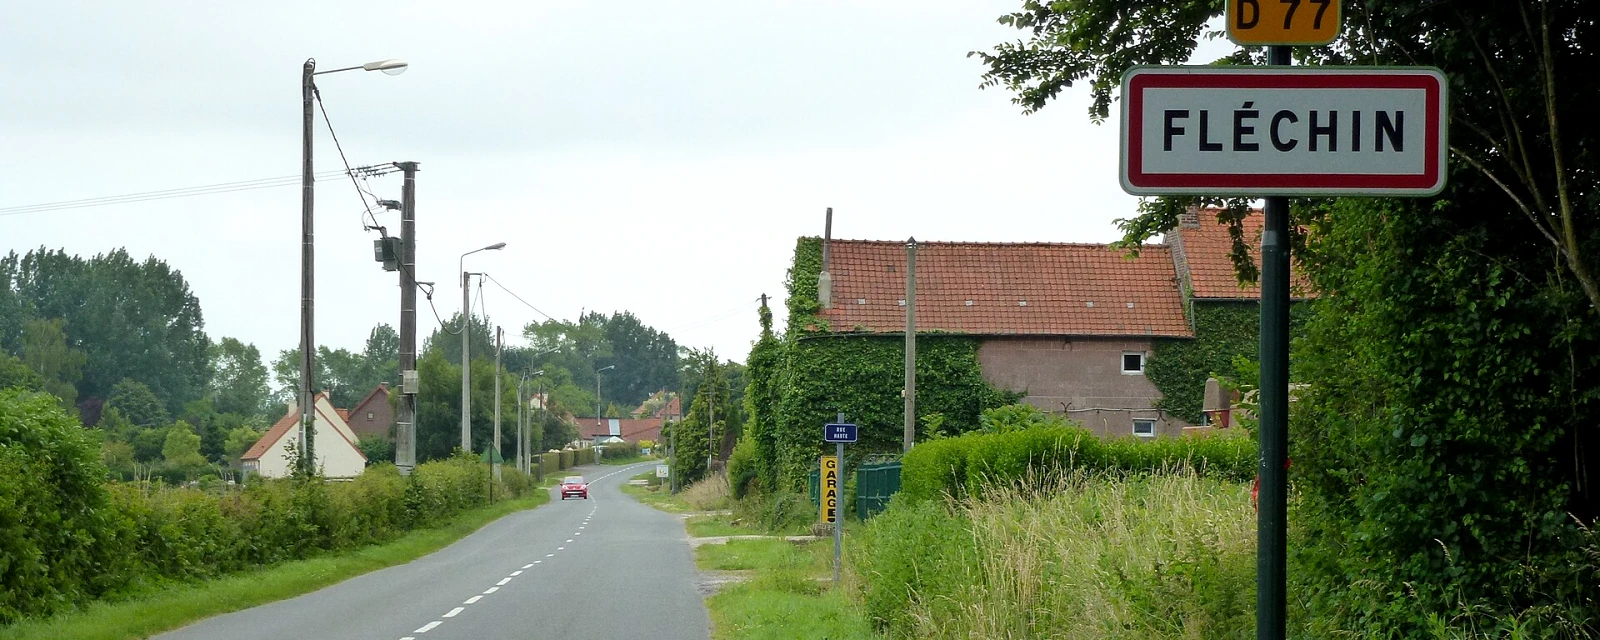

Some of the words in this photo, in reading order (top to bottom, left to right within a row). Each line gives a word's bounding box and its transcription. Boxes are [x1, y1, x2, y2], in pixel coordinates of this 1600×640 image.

[1236, 0, 1260, 30] D
[1280, 0, 1331, 30] 77
[1163, 101, 1405, 153] FLÉCHIN
[826, 460, 837, 517] GARAGE
